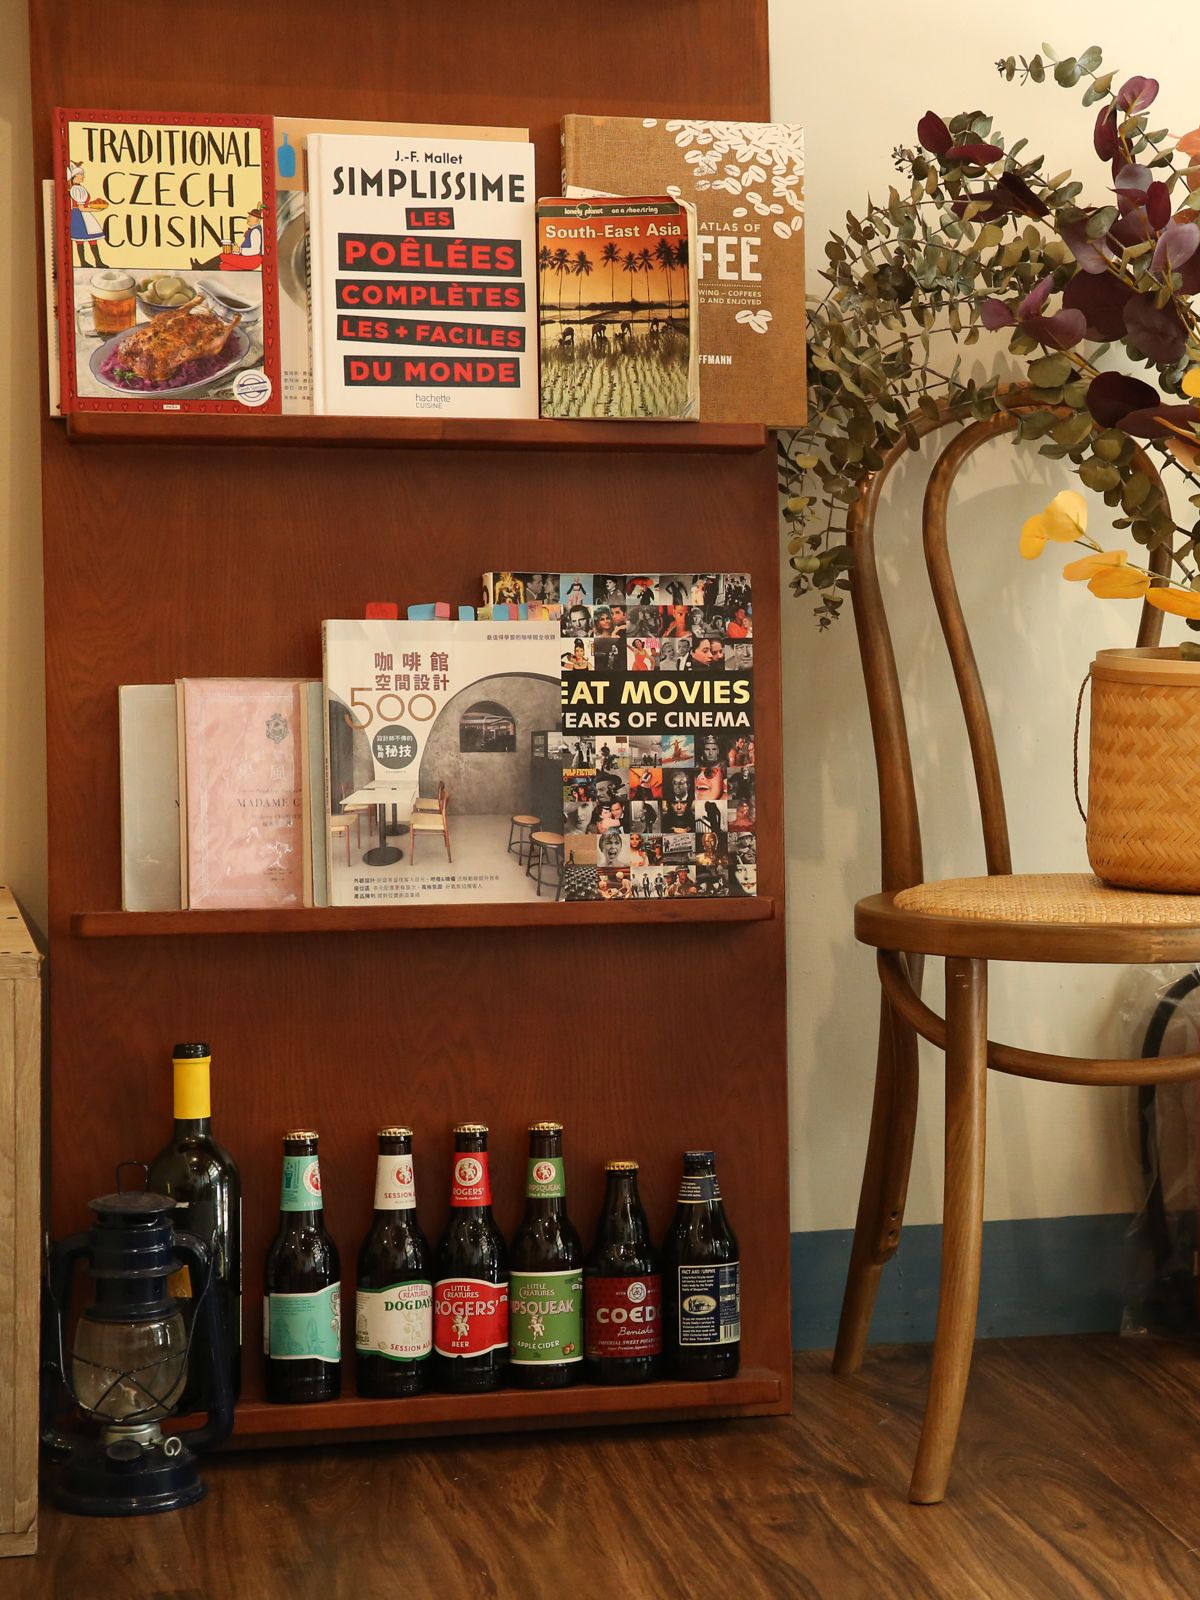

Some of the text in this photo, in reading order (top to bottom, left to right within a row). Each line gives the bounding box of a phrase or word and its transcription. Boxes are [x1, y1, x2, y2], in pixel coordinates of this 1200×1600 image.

[82, 127, 260, 168] TRADITIONAL
[395, 150, 462, 164] J.-F. Mallet
[102, 172, 234, 208] CZECH
[332, 166, 525, 203] SIMPLISSIME
[410, 211, 451, 226] LES
[564, 208, 583, 216] lonely
[584, 208, 604, 216] planet
[626, 206, 658, 214] shoestring
[545, 222, 681, 239] South-East Asia
[700, 222, 760, 232] ATLAS OF
[345, 237, 516, 270] POÊLÉES
[697, 235, 762, 282] FEE
[342, 282, 520, 308] COMPLÈTES
[342, 320, 389, 340] LES
[416, 325, 522, 348] FACILES
[350, 361, 515, 382] DU MONDE
[415, 393, 450, 402] hachette
[374, 652, 449, 672] 咖啡館
[375, 674, 450, 692] 空間設計
[620, 680, 750, 704] MOVIES
[344, 687, 437, 730] 500
[562, 711, 750, 728] EARS OF CINEMA
[384, 1300, 412, 1312] DOG
[434, 1300, 499, 1316] ROGERS'
[390, 1344, 420, 1352] SESSION
[517, 1340, 560, 1350] APPLE CIDER
